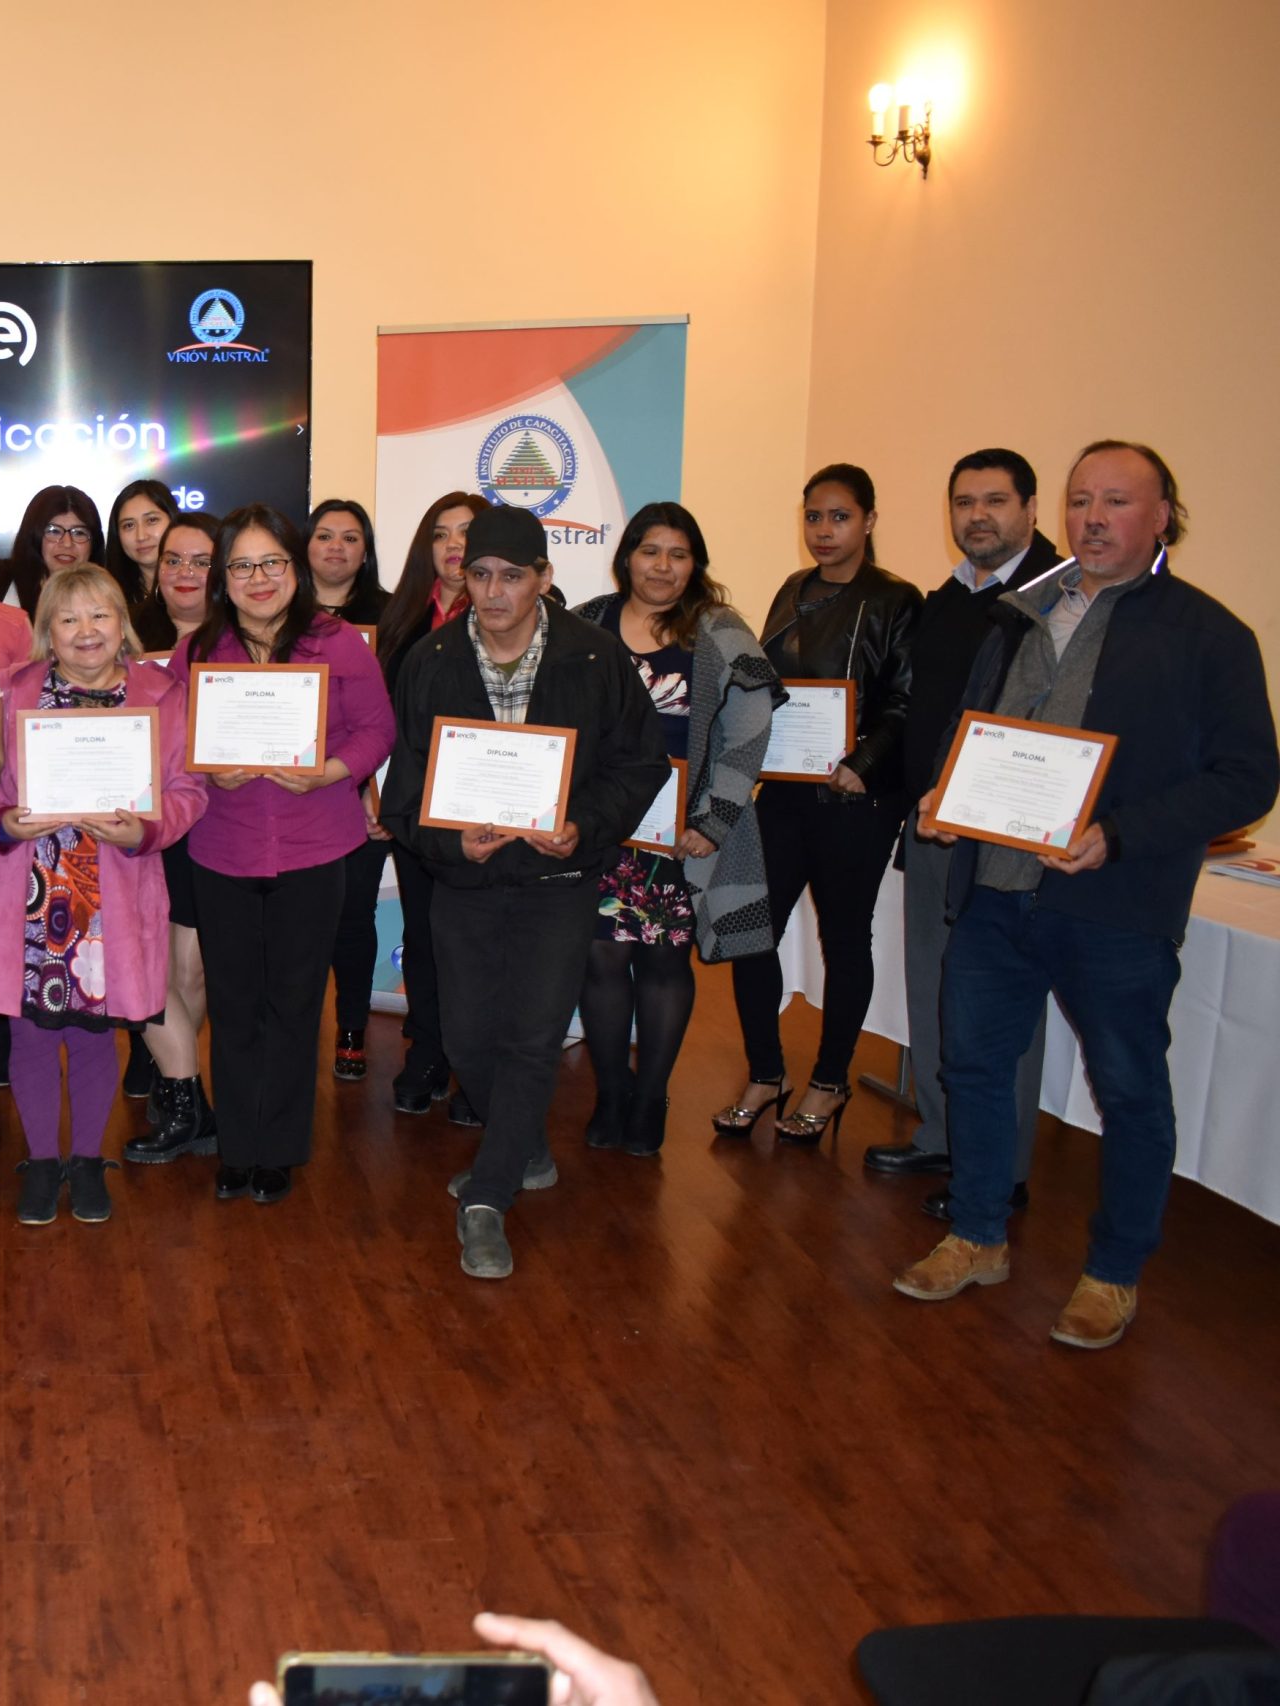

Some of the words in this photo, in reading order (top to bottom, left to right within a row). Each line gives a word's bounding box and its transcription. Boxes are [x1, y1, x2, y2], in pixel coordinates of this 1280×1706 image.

[166, 349, 208, 363] VISIÓN
[211, 351, 269, 362] AUSTRAL
[480, 427, 509, 476] INSTITUTO
[509, 419, 524, 430] DE
[525, 418, 574, 476] CAPACITACION
[486, 748, 518, 758] DIPLOMA
[1011, 750, 1046, 763] DIPLOMA
